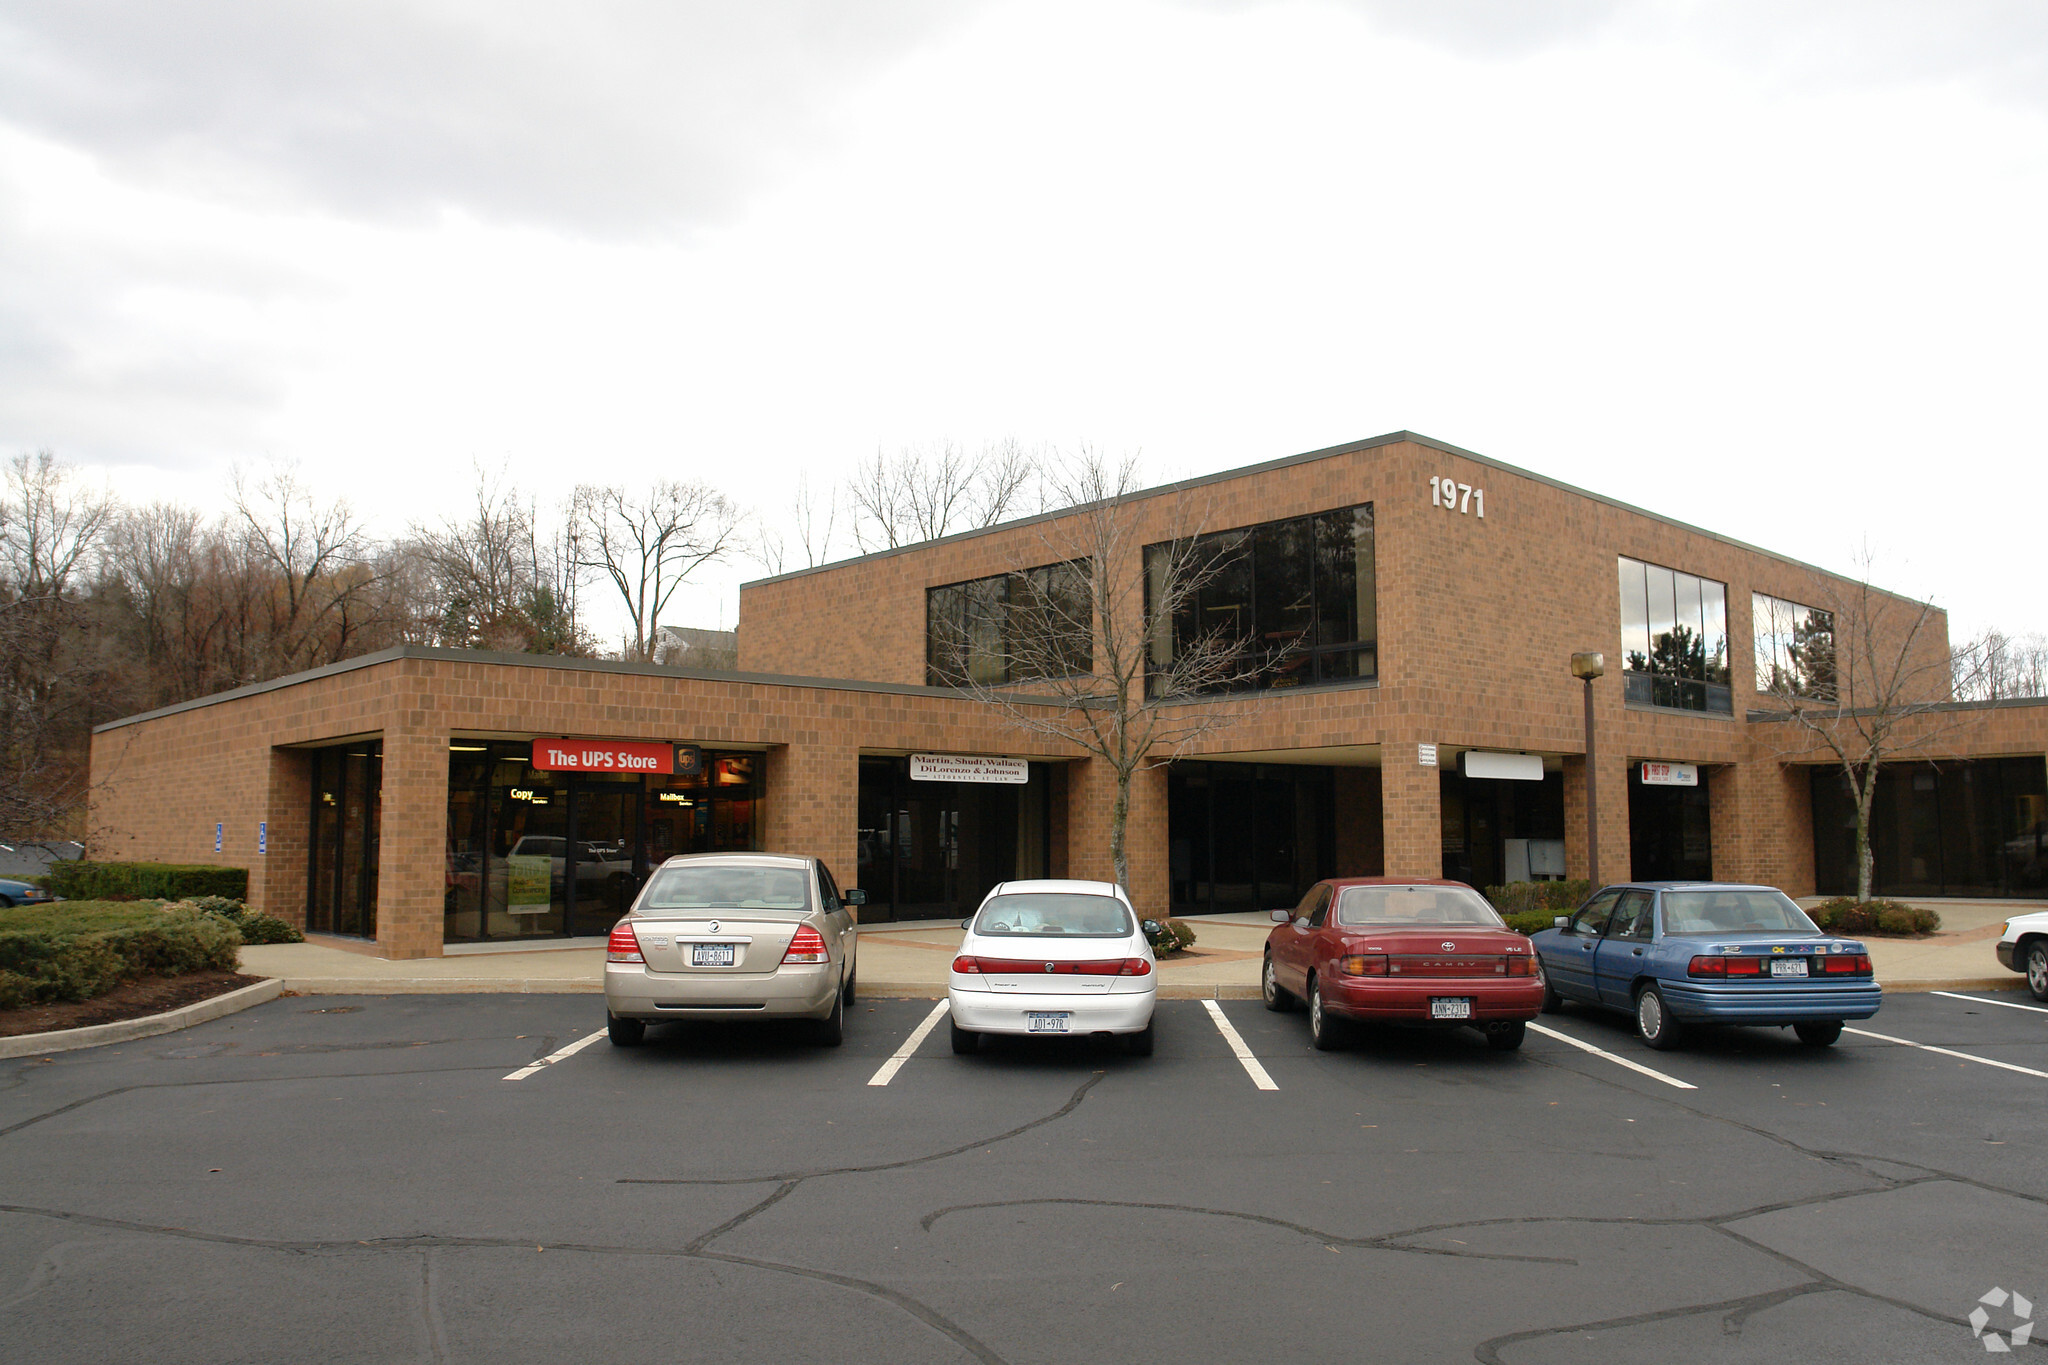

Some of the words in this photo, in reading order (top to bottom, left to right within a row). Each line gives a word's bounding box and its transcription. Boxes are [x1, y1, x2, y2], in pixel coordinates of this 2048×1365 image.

[1430, 476, 1484, 519] 1971
[548, 750, 577, 766] The
[582, 751, 614, 767] UPS
[618, 752, 657, 769] Store
[914, 756, 953, 765] Martin,
[986, 759, 1025, 768] Wallace,
[920, 765, 970, 774] DiLorenzo
[983, 768, 1020, 776] Johnson
[510, 788, 534, 800] Copy
[660, 793, 684, 801] Mailbox
